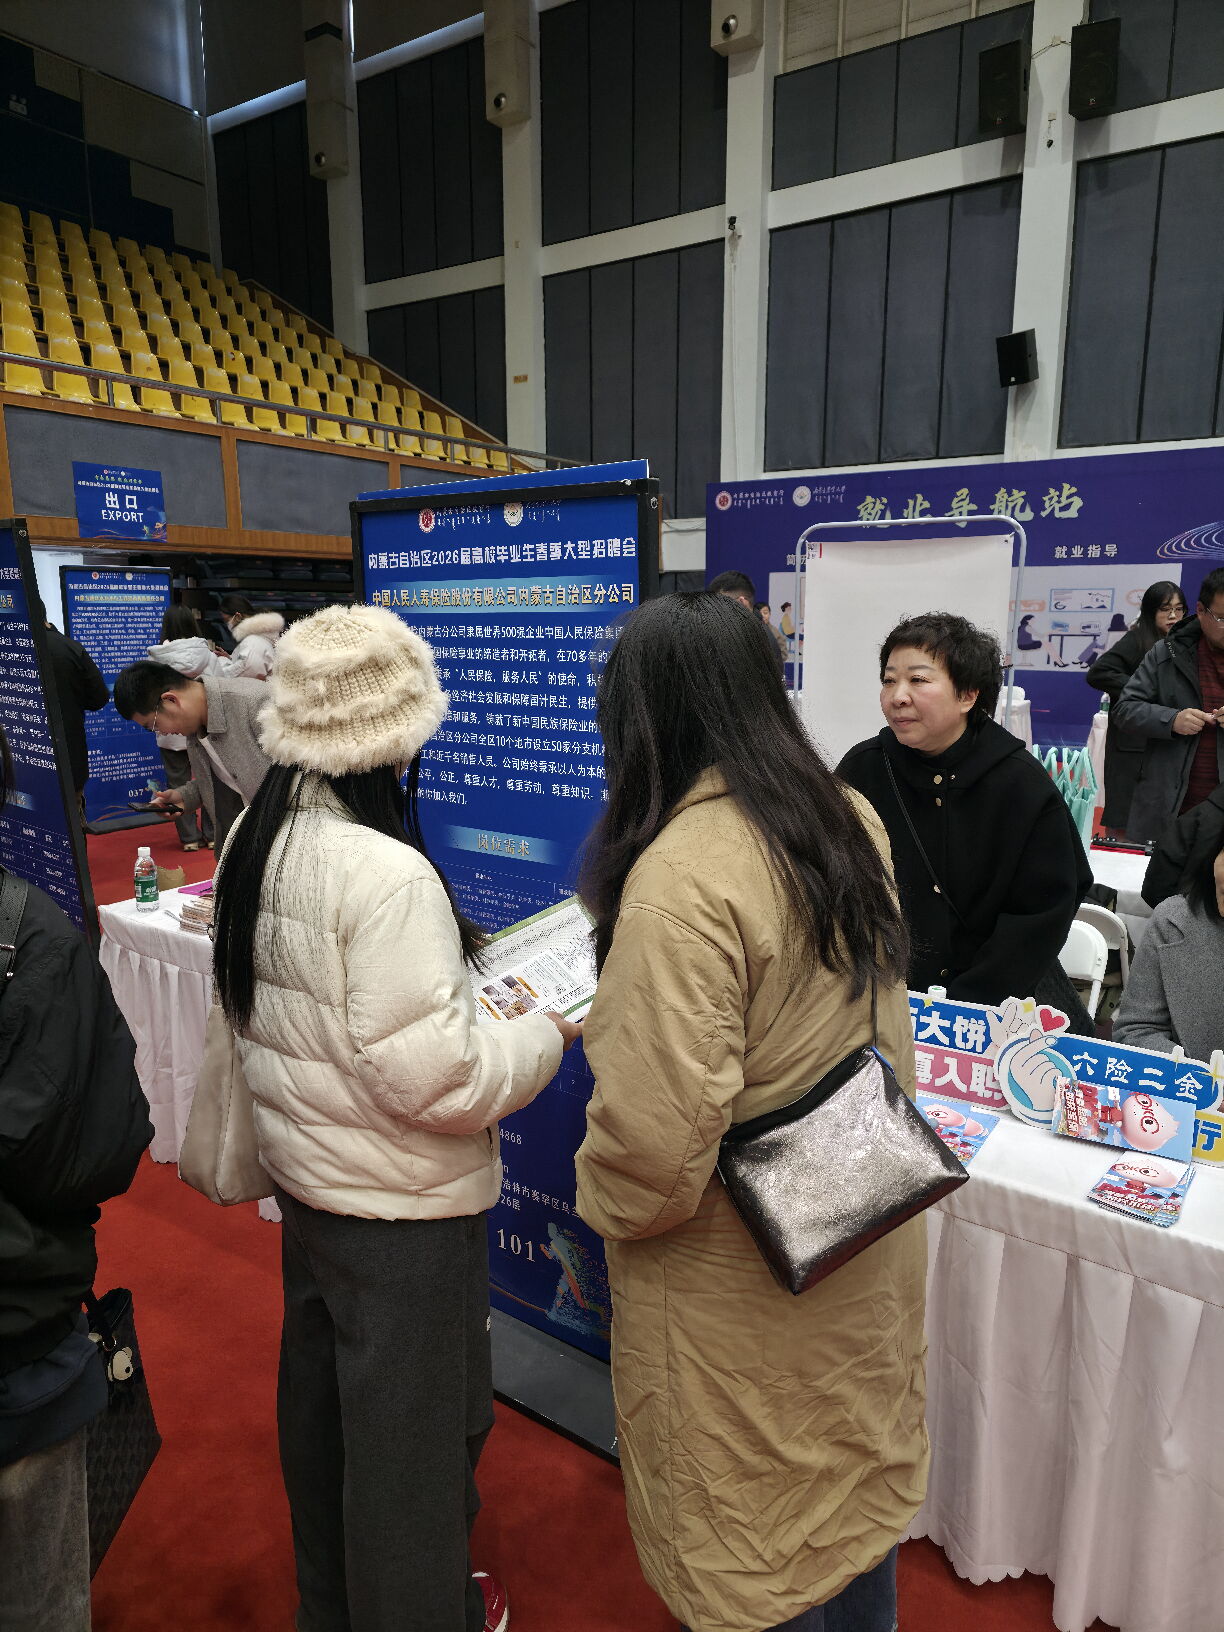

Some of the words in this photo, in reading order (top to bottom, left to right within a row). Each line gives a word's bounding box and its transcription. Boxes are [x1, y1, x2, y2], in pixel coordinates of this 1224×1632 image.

[105, 491, 138, 509] 出口
[101, 509, 144, 523] EXPORT
[368, 536, 636, 570] 内蒙古自治区2026届高校毕业生春季大型招聘会
[1054, 543, 1119, 559] 就业指导
[372, 582, 635, 608] 中国人民人寿保险股份有限公司内蒙古自治区分公司
[128, 788, 144, 798] 037
[477, 833, 531, 857] 岗位需求
[1072, 1051, 1204, 1101] 六险二金
[500, 1128, 522, 1145] 4868
[1192, 1118, 1222, 1152] 行
[496, 1228, 536, 1263] 101
